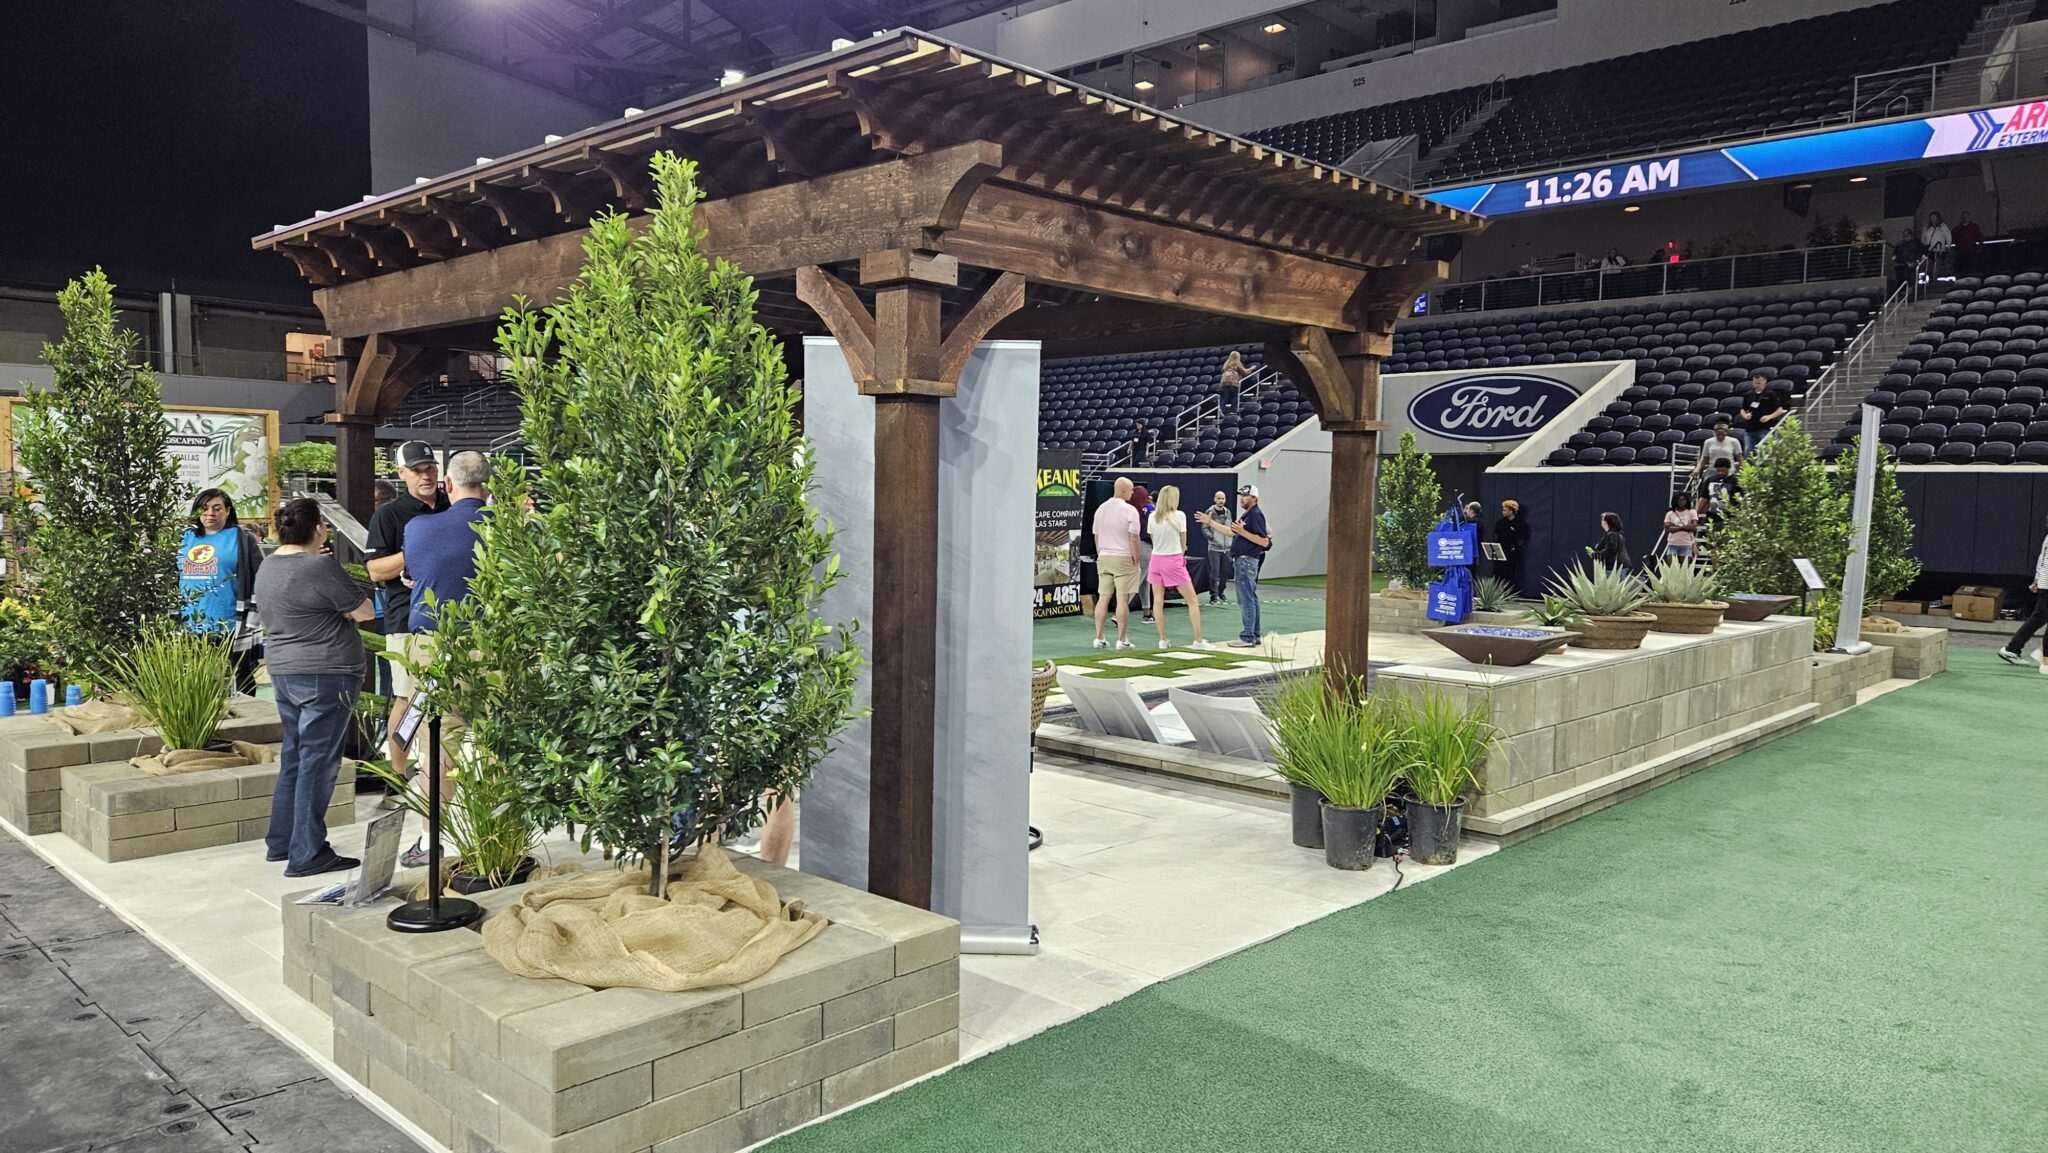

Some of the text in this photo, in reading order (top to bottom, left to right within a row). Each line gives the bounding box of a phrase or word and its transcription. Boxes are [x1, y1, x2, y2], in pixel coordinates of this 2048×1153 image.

[1525, 159, 1680, 207] 11:26 AM
[1440, 385, 1548, 429] Ford
[1037, 468, 1080, 496] KEANE
[1051, 510, 1080, 518] COMPANY
[1053, 584, 1081, 605] 4851
[1033, 604, 1081, 618] SCAPING.COM
